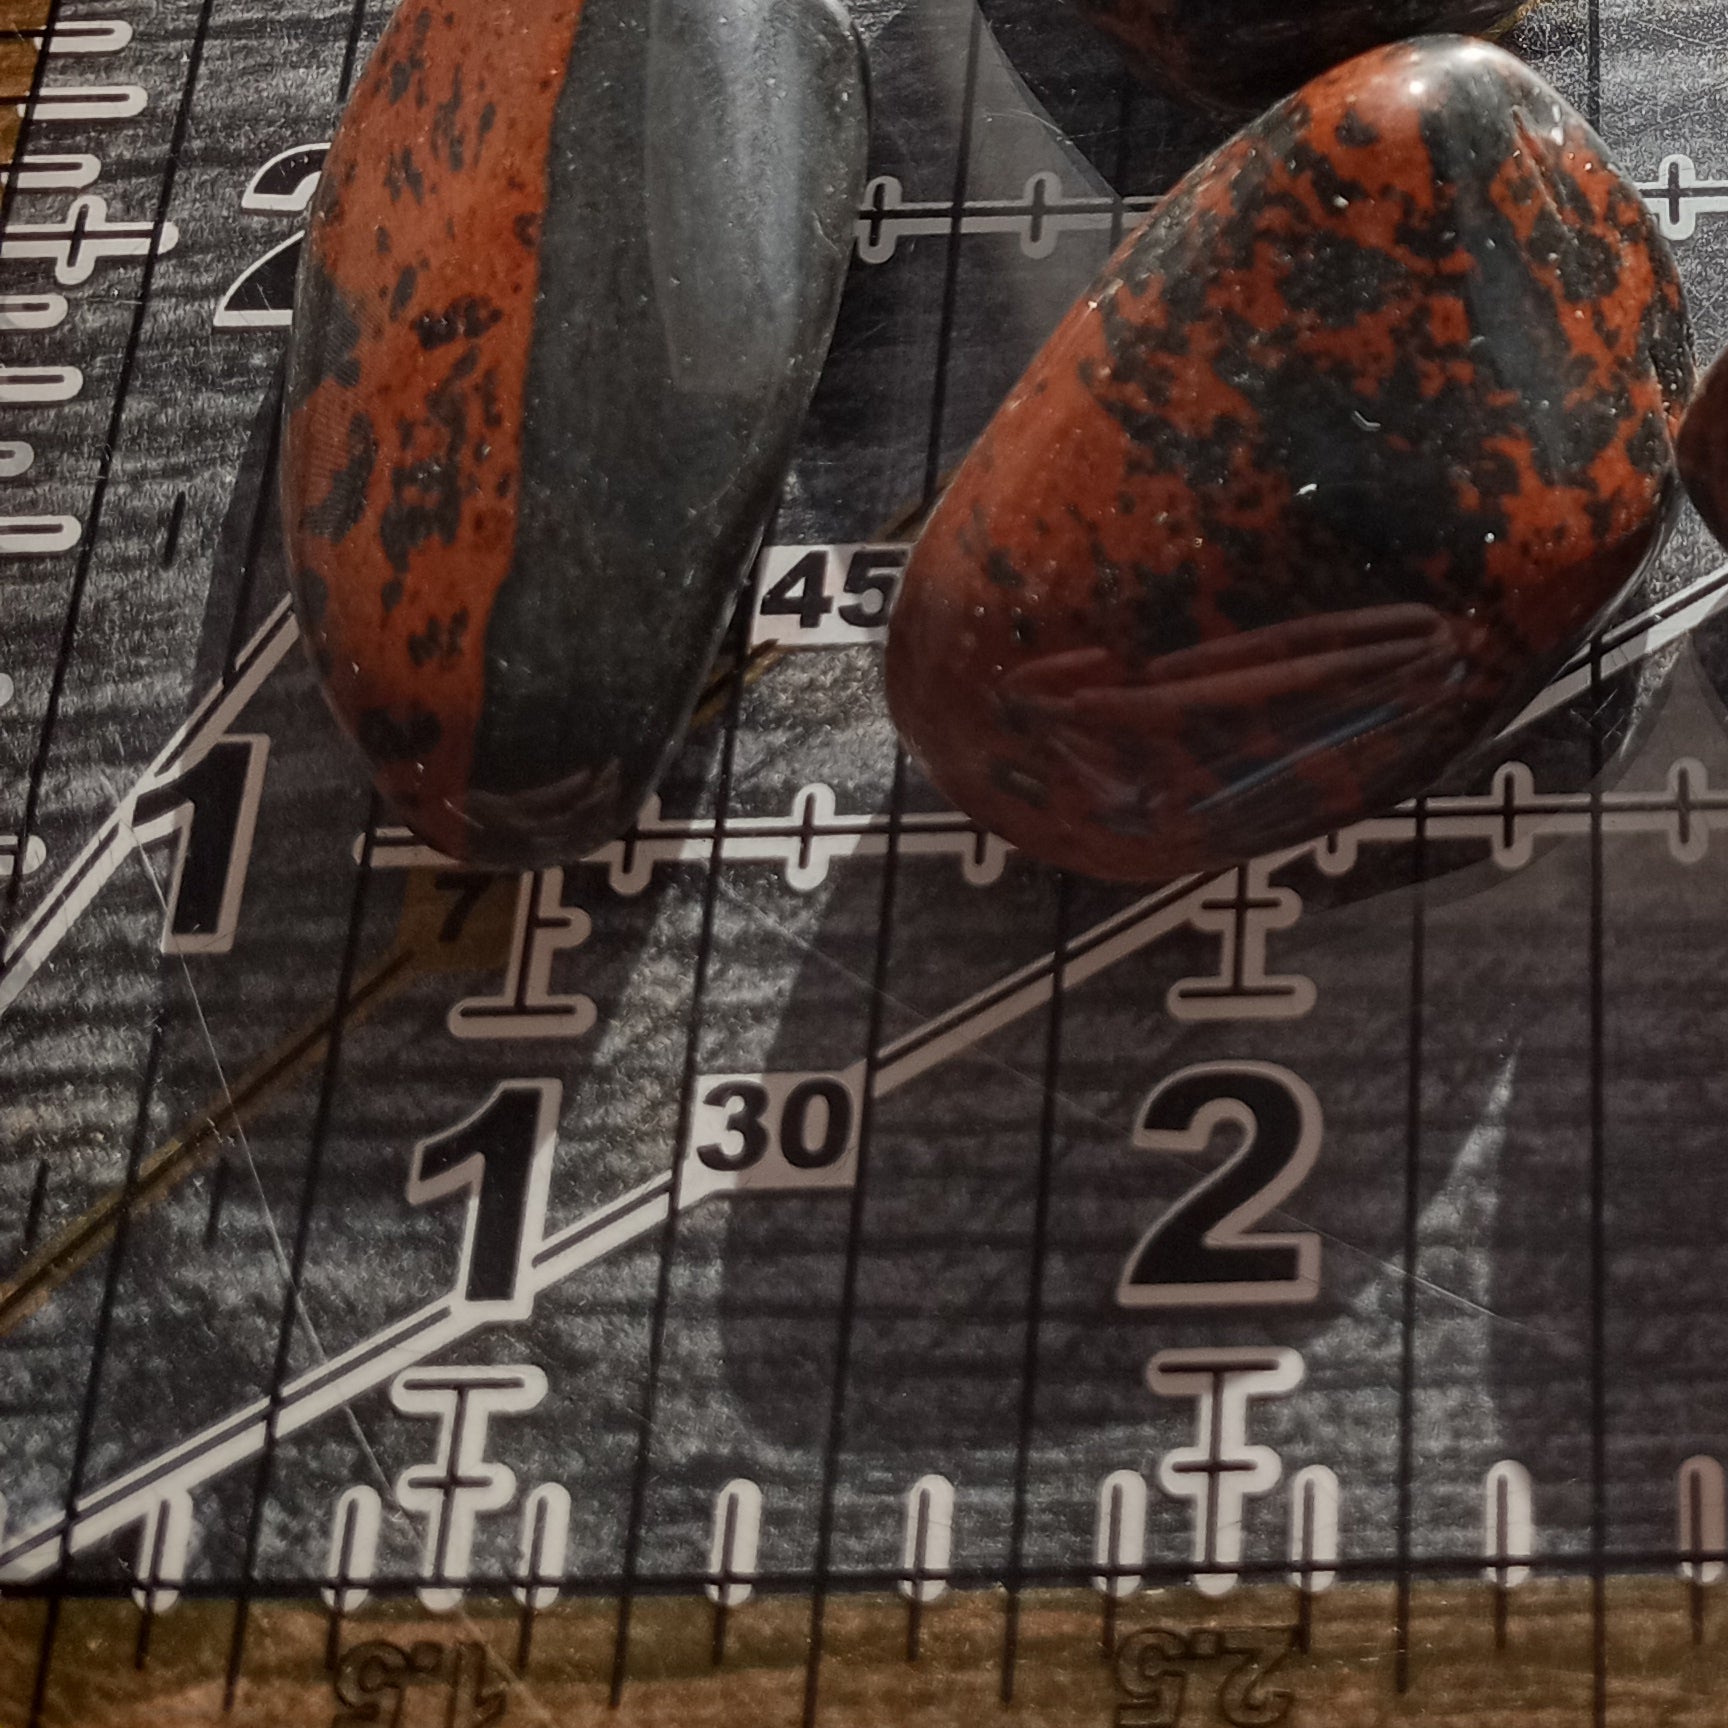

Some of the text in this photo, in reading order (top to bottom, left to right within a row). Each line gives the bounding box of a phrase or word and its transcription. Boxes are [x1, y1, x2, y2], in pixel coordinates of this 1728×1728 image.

[760, 548, 908, 628] 45
[129, 734, 271, 953] 1
[435, 872, 492, 944] 7
[697, 1078, 856, 1171] 30
[408, 1078, 563, 1320] 1
[1117, 1059, 1324, 1306] 2
[1114, 1625, 1296, 1728] 2.5
